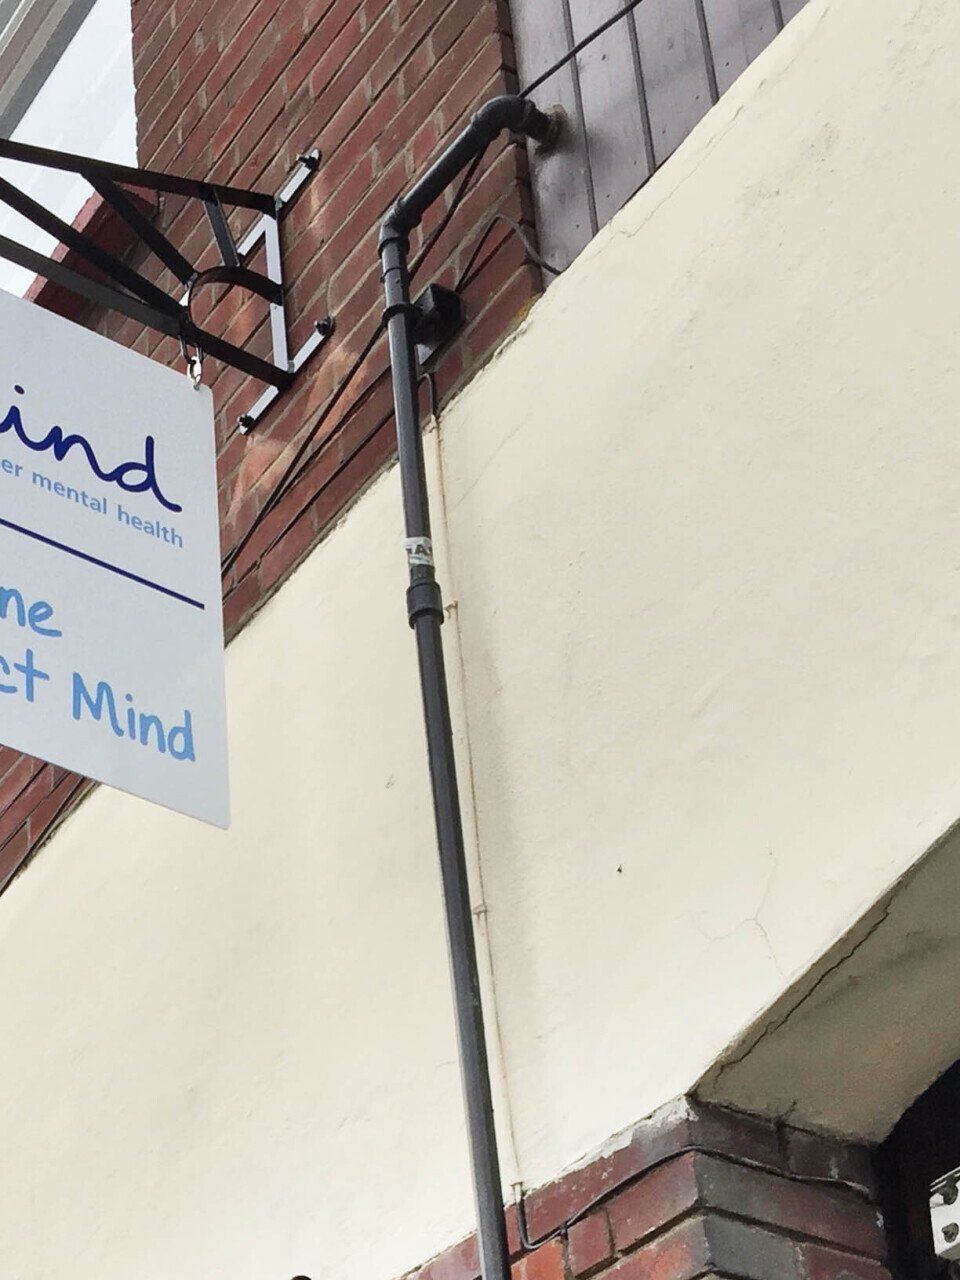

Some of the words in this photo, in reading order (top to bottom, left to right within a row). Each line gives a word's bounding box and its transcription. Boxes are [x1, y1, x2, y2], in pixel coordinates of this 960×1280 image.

[31, 470, 107, 515] mental
[117, 504, 183, 549] health
[72, 671, 196, 762] Mind
